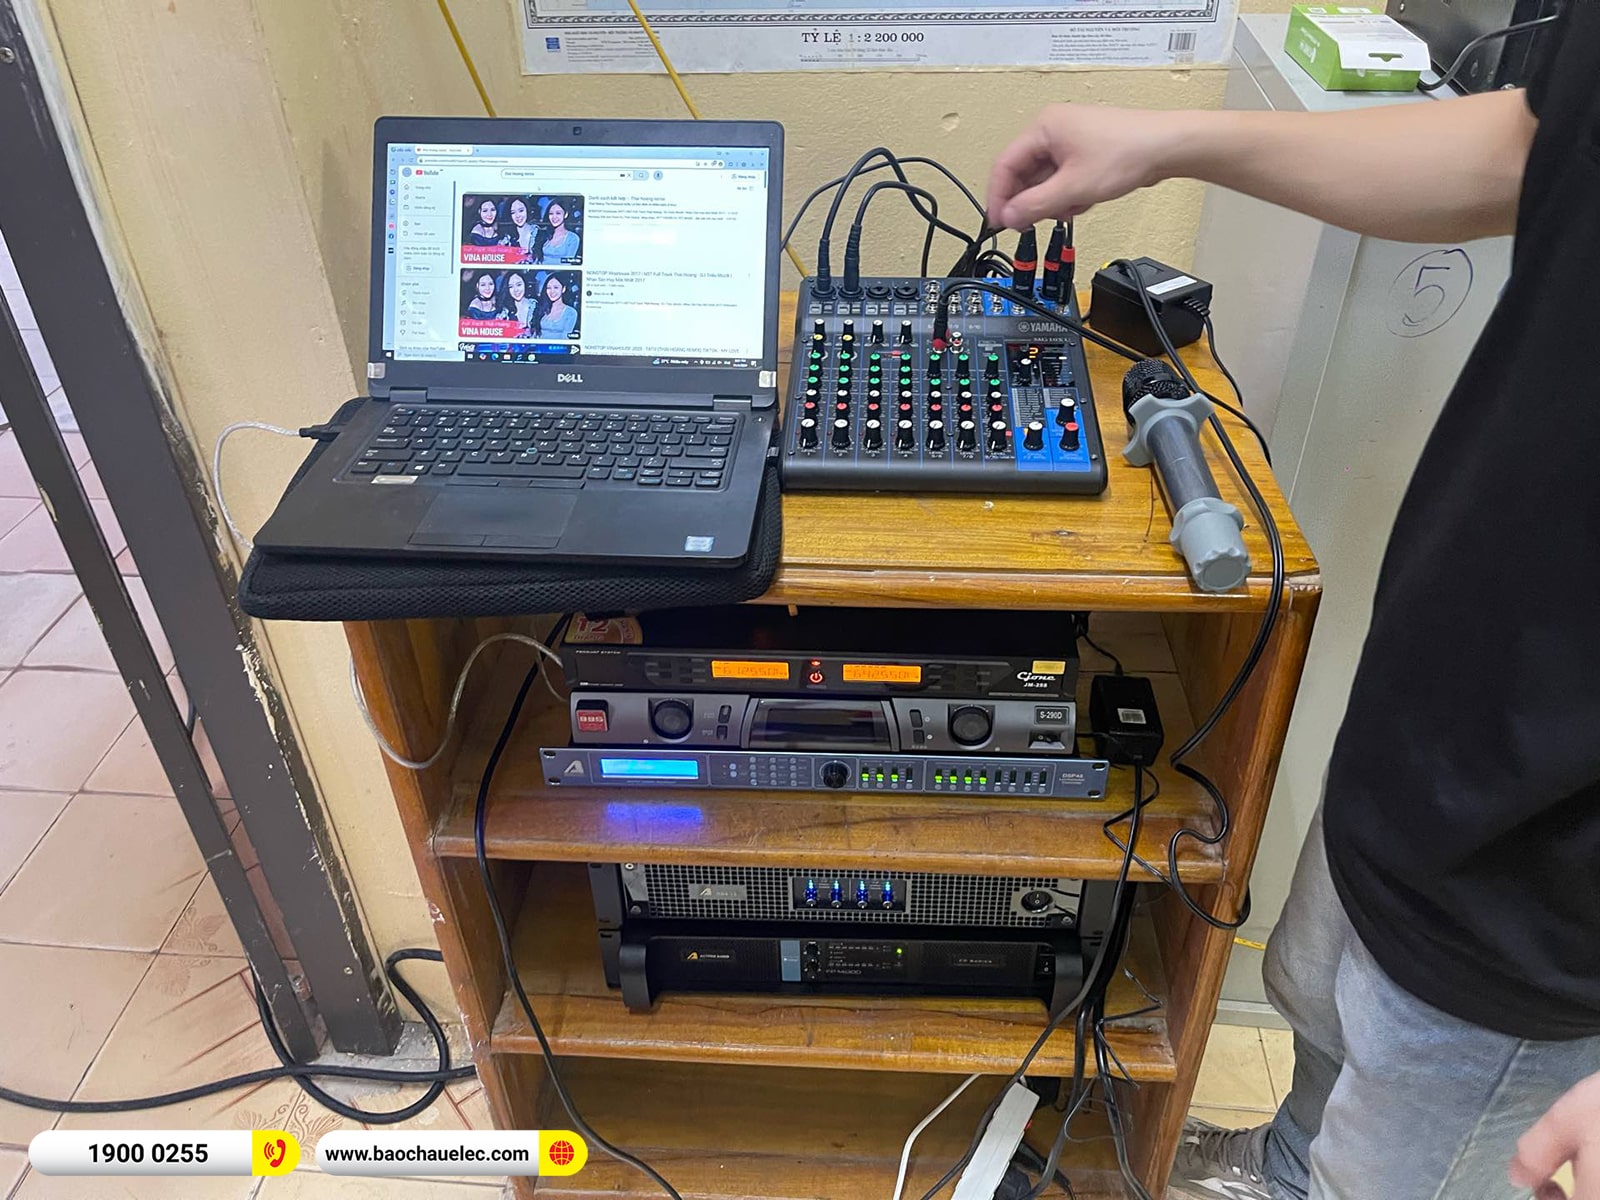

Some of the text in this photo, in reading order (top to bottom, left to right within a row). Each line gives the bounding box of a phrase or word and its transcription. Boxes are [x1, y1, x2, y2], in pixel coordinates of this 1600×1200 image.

[801, 28, 820, 42] TỶ
[824, 29, 842, 45] LỆ
[864, 32, 872, 42] 2
[874, 32, 898, 42] 200
[901, 32, 924, 42] 000
[482, 254, 505, 262] HOUSE
[1402, 265, 1451, 327] 5
[461, 328, 504, 336] VINA HOUSE
[557, 373, 584, 383] DELL
[1040, 711, 1062, 720] S-290D
